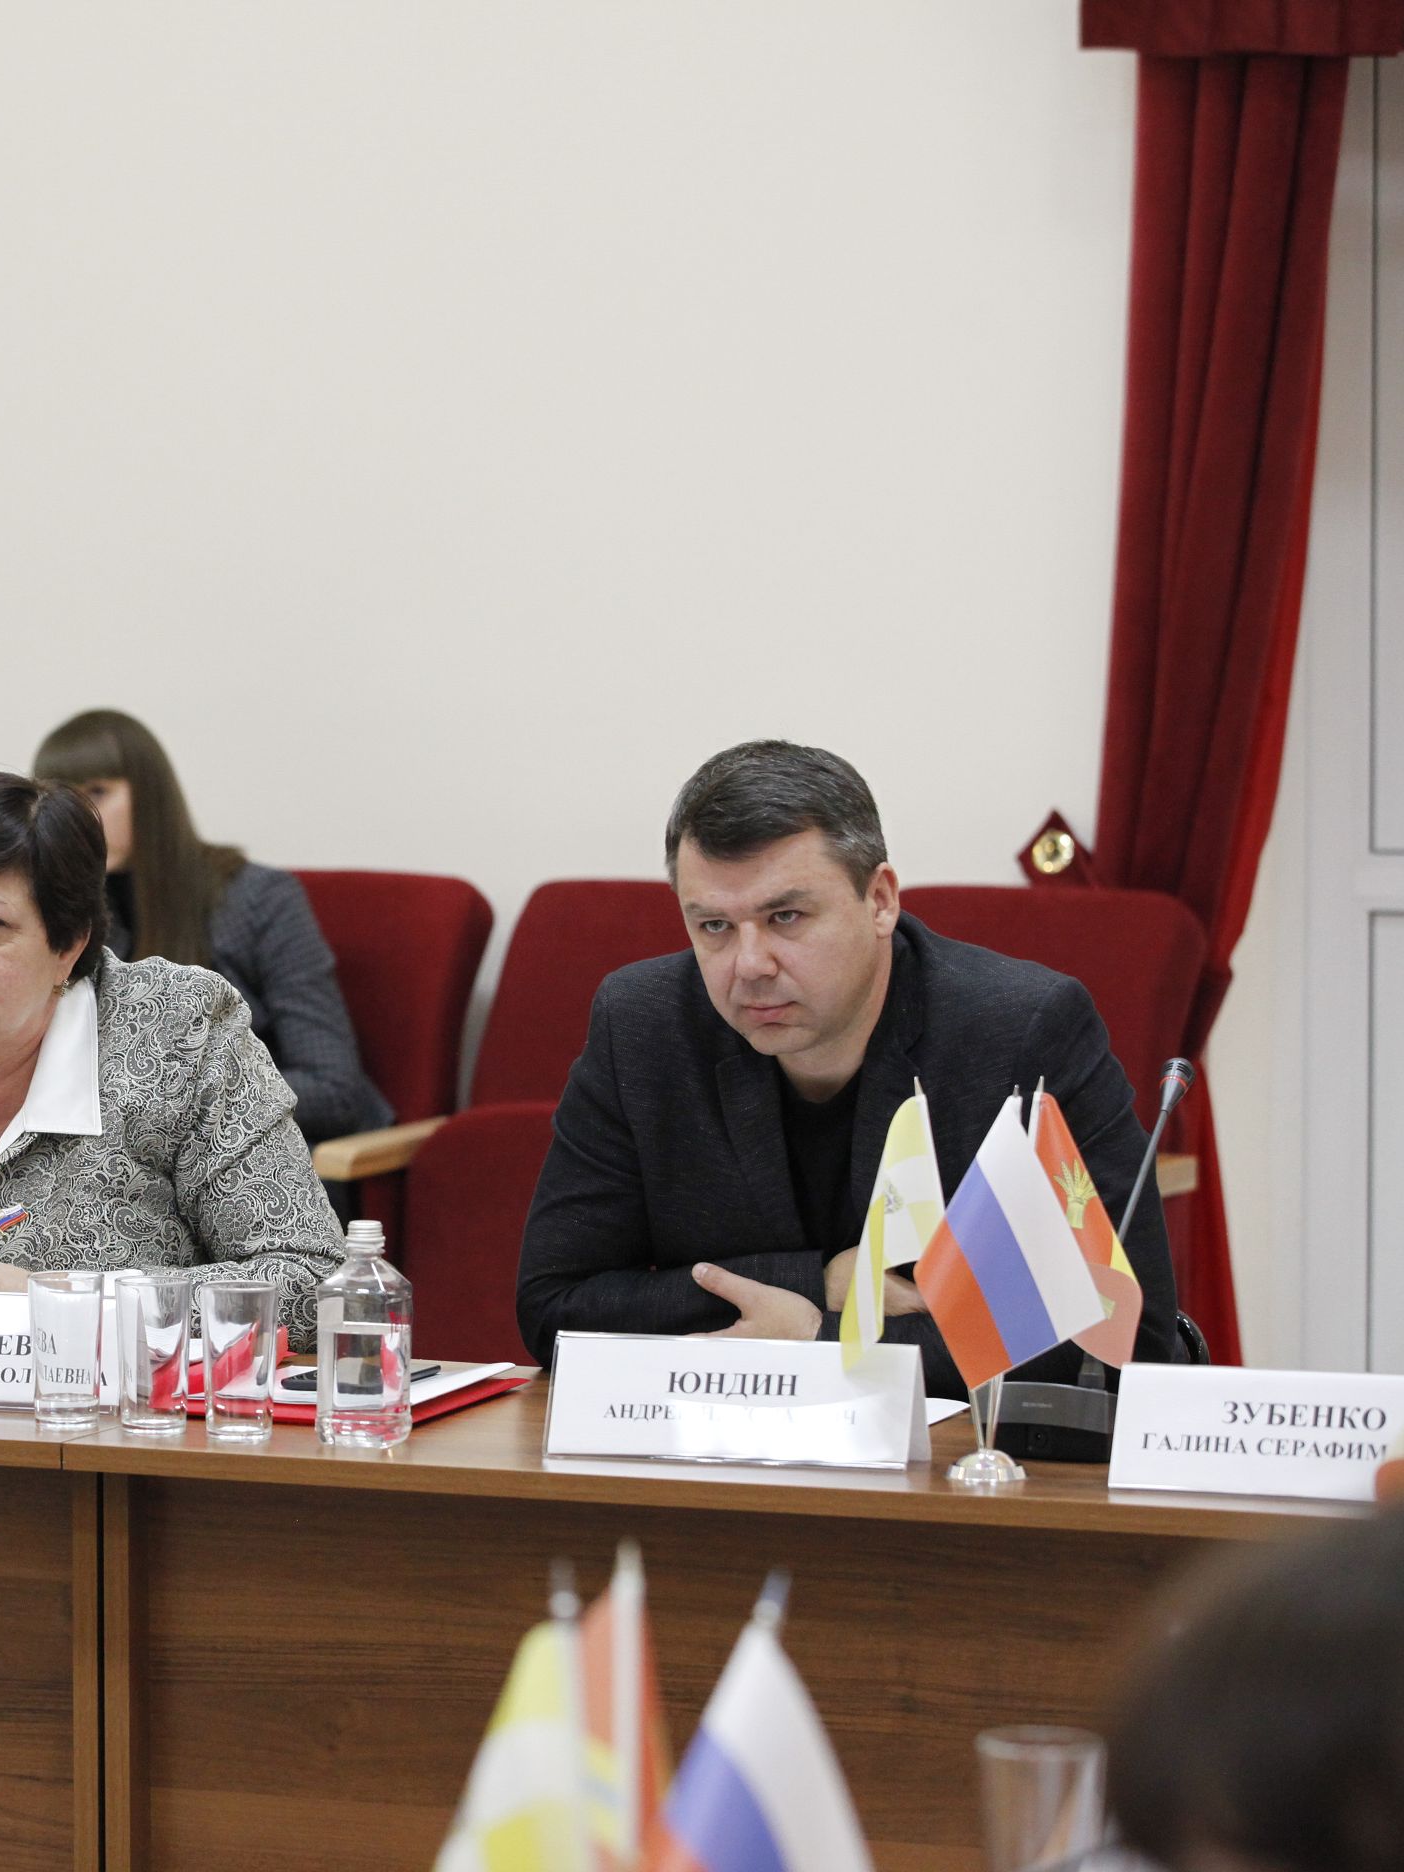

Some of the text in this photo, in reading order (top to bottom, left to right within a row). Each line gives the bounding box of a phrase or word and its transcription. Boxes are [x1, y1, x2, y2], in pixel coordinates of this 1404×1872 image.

[668, 1371, 799, 1399] ЮНДИН
[604, 1403, 680, 1422] АНДРЕ
[1221, 1400, 1387, 1430] ЗУБЕНКО
[1142, 1432, 1388, 1461] ГАЛИНА СЕРАФИМ
